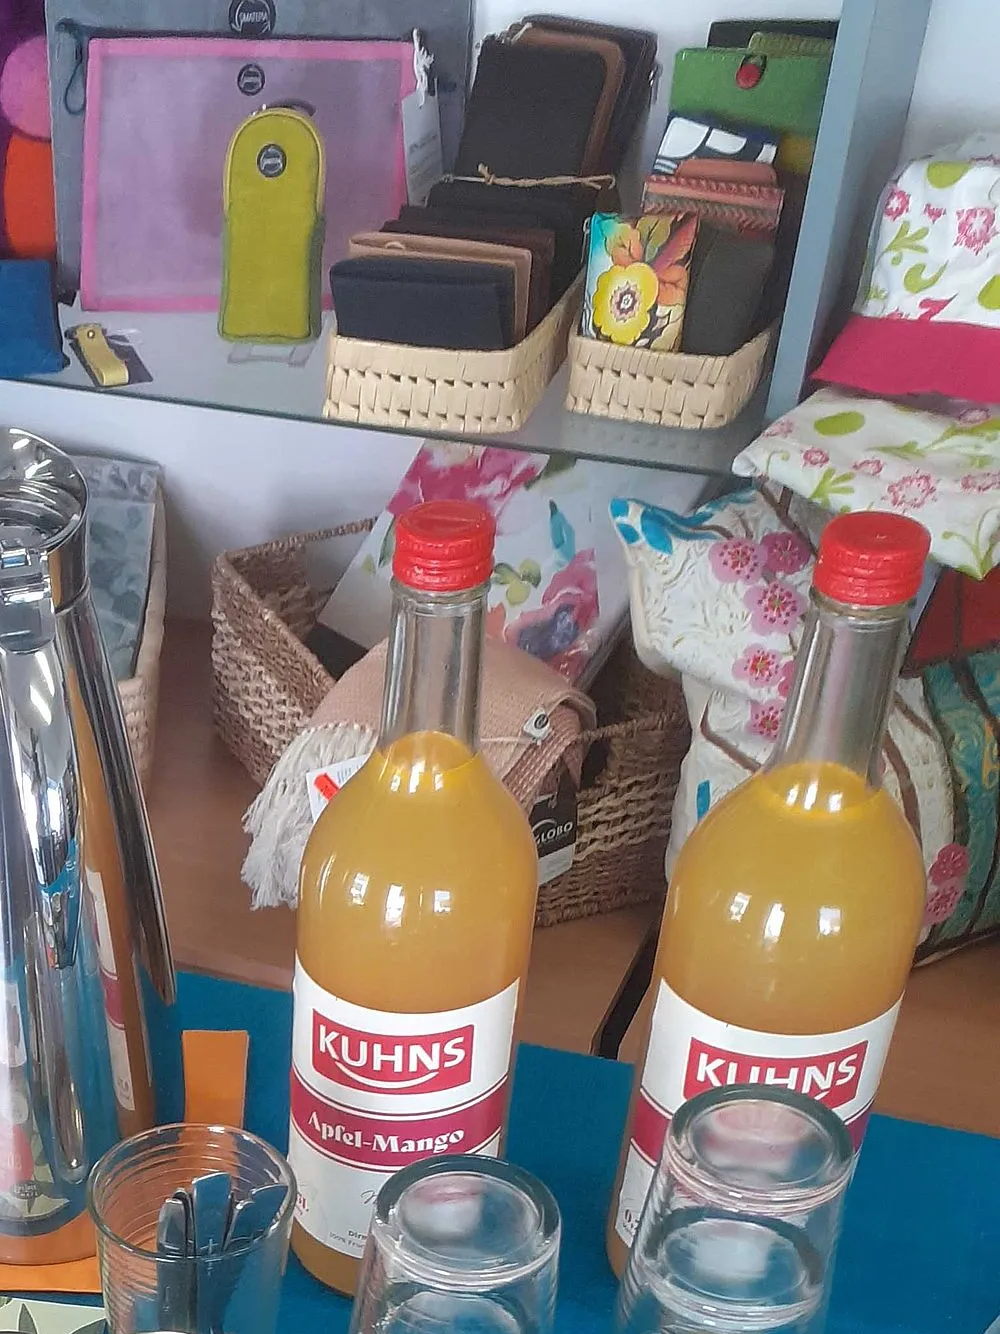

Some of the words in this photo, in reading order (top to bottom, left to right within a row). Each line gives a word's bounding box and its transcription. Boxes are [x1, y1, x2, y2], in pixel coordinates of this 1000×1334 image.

[318, 1024, 466, 1074] KUHNS
[696, 1053, 858, 1096] KUHNS
[308, 1110, 465, 1154] Apfel-Mango
